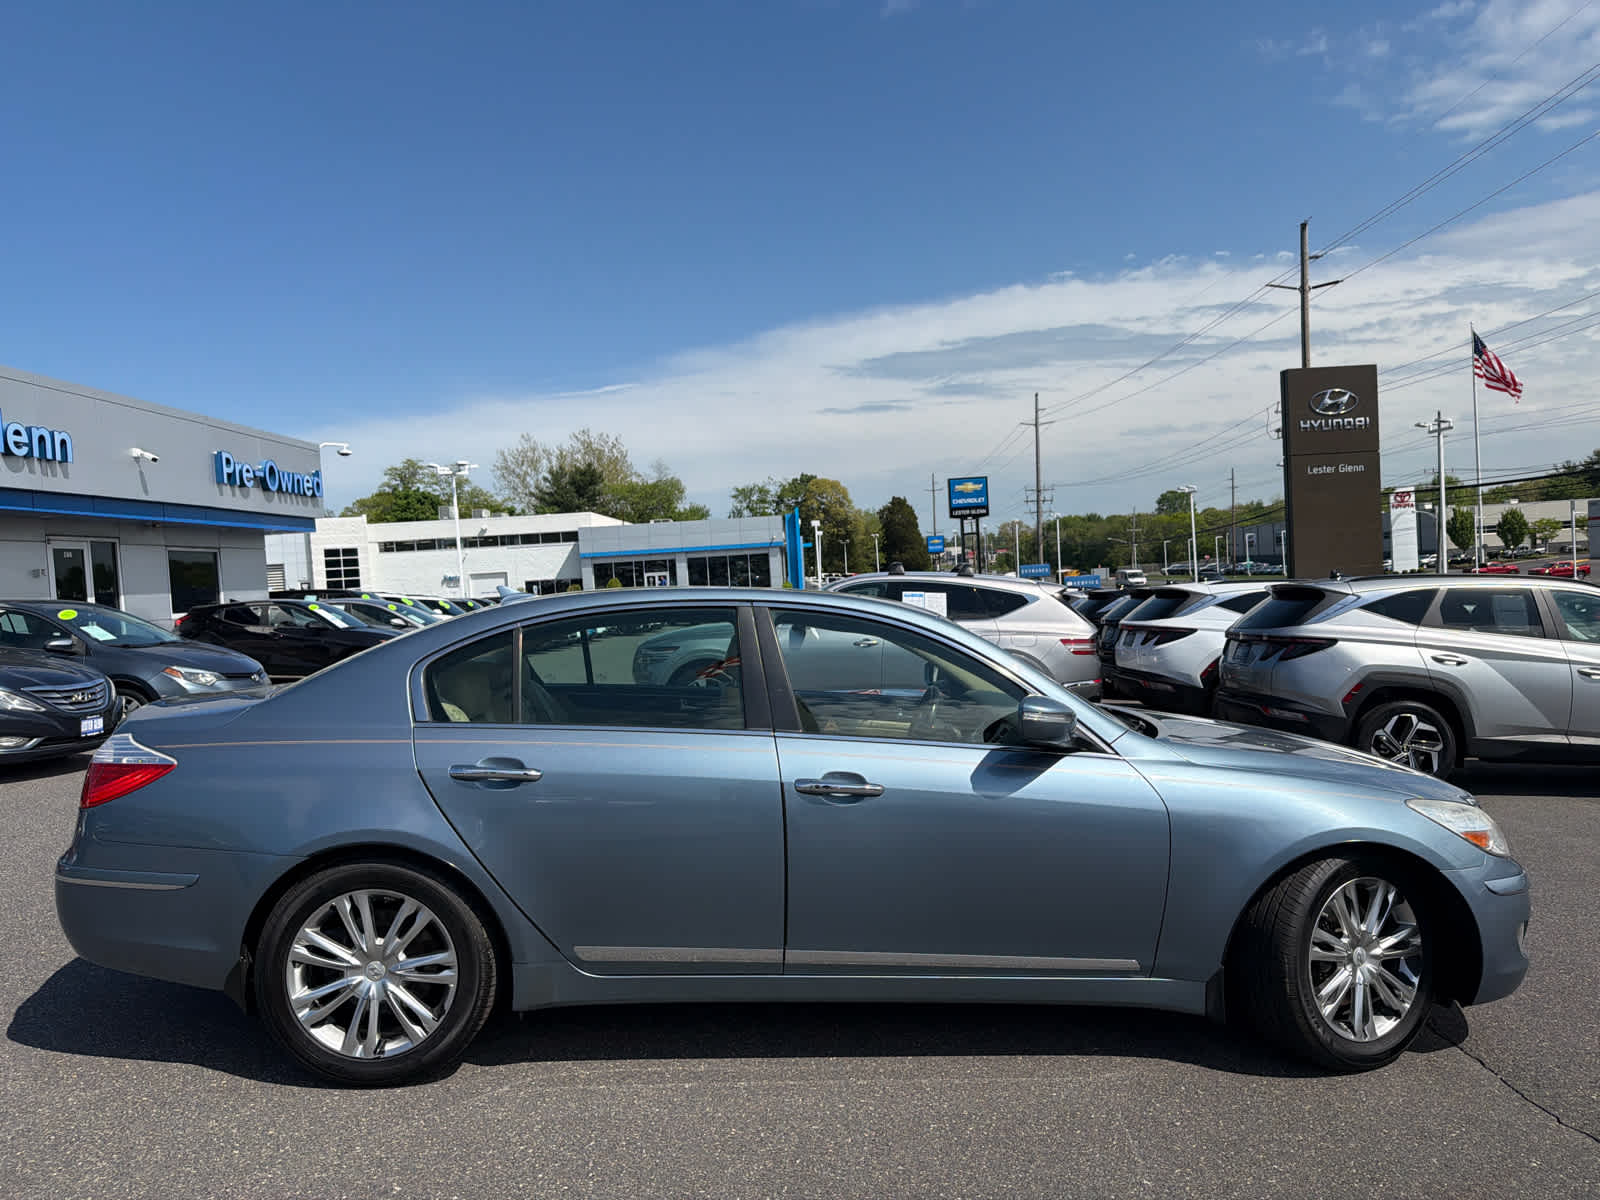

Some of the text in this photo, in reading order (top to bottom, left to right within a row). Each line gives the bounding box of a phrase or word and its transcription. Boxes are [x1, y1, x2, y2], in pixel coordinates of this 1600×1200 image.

[1300, 416, 1370, 431] HYUNDAI
[215, 450, 323, 498] Pre-Owned
[1307, 463, 1365, 474] Lester Glenn
